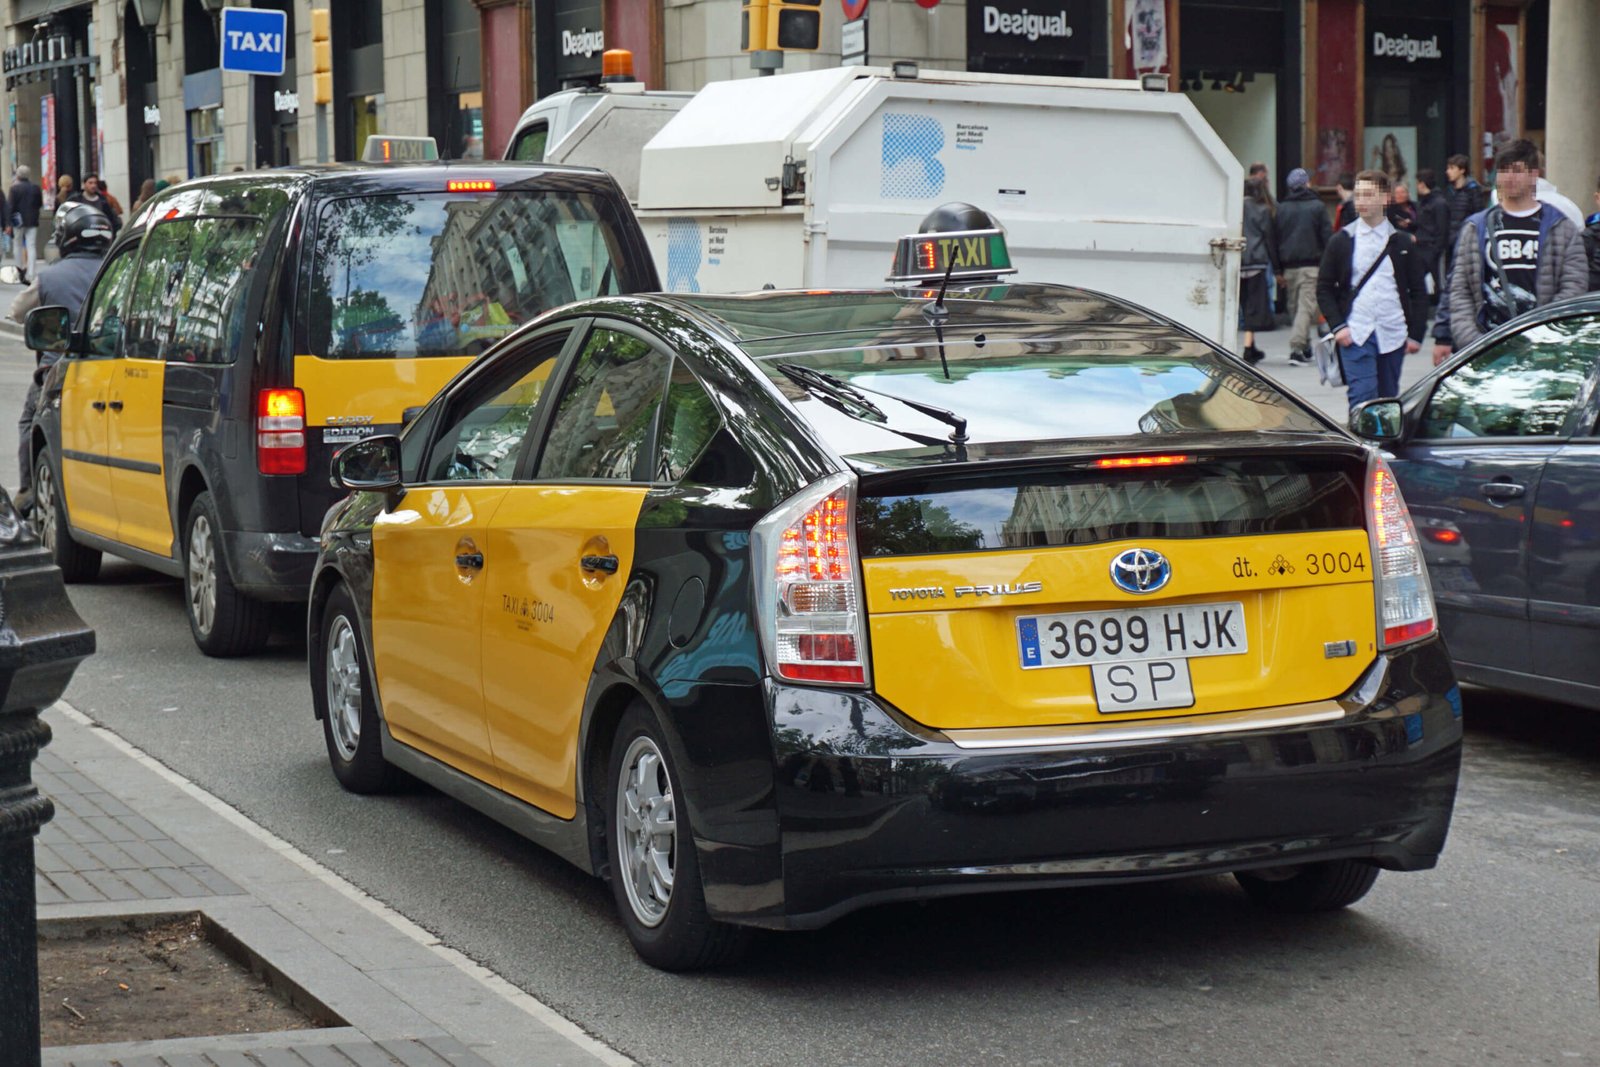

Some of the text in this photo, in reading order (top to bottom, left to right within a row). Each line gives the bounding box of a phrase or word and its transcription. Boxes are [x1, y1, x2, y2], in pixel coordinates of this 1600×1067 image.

[227, 30, 281, 53] TAXI
[562, 27, 605, 58] Desigua
[391, 141, 424, 160] TAXI
[938, 237, 987, 269] TAXI
[323, 427, 374, 437] EDITION
[326, 415, 374, 426] CADDY
[1232, 552, 1366, 578] dt. 3004
[889, 581, 1042, 600] TOYOTA PRIUS
[502, 594, 554, 624] TAXI 3004
[1048, 609, 1237, 660] 3699 HJK
[1026, 647, 1036, 659] E
